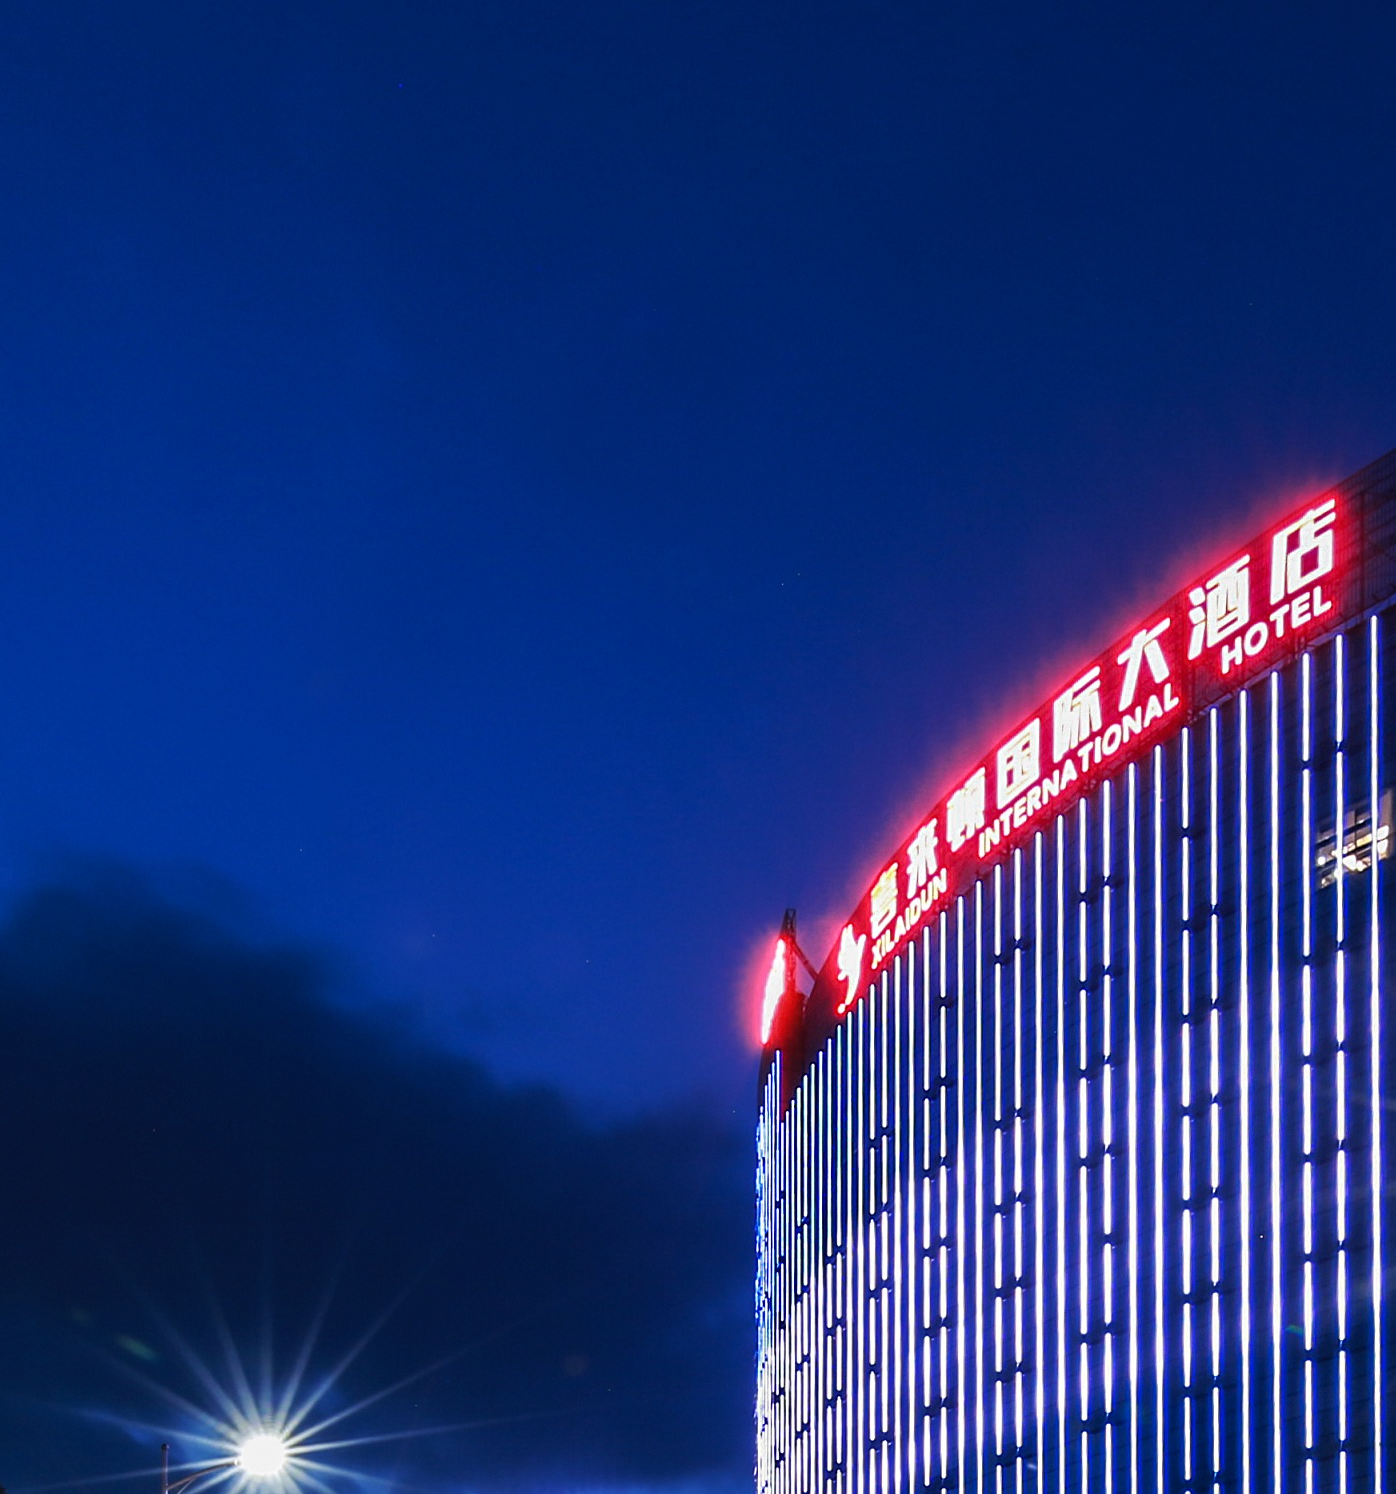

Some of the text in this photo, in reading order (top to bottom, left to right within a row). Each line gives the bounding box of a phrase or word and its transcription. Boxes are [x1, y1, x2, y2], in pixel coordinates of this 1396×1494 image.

[871, 585, 1332, 970] XILAIDUN INTERNATIONAL HOTEL
